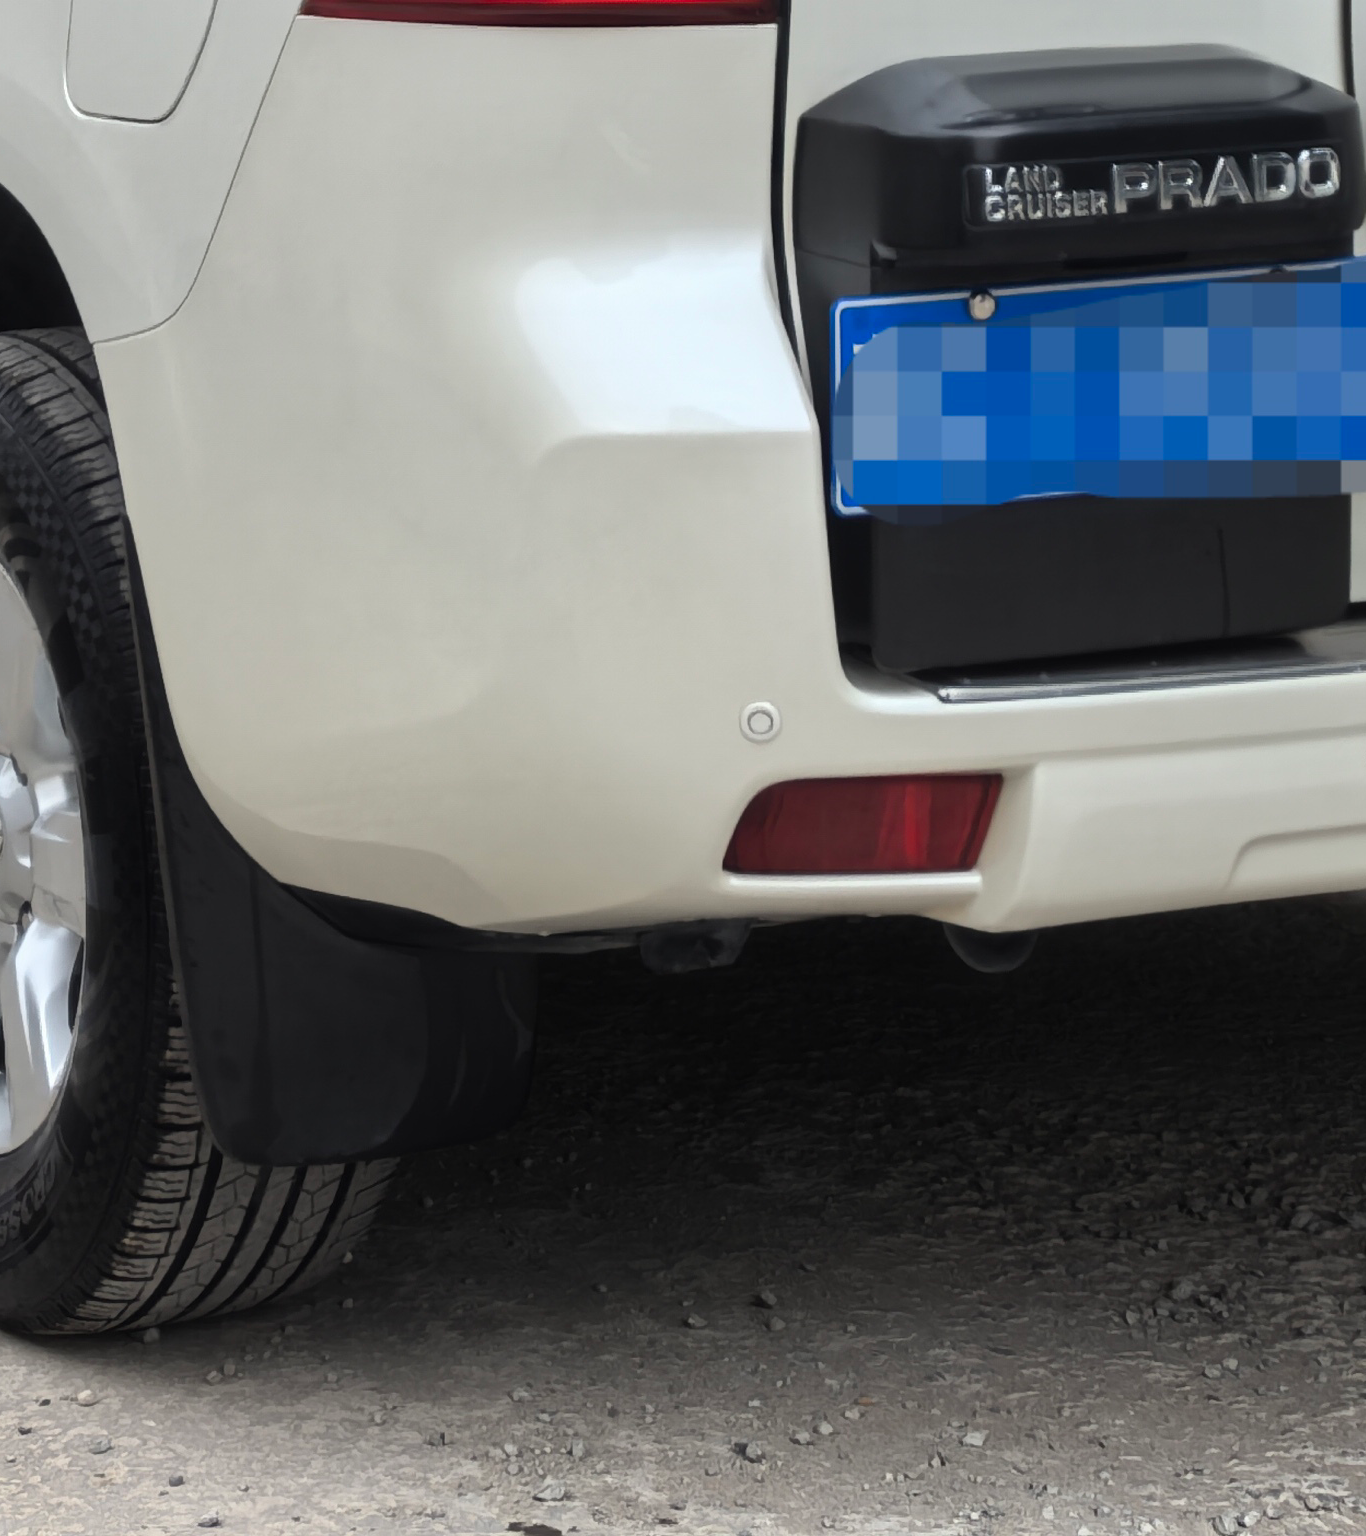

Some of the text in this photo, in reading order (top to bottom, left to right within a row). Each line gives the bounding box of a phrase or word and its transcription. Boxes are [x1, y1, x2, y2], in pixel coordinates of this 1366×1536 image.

[985, 164, 1062, 193] LAND
[1112, 147, 1341, 215] PRADO
[985, 189, 1109, 222] CRUISER
